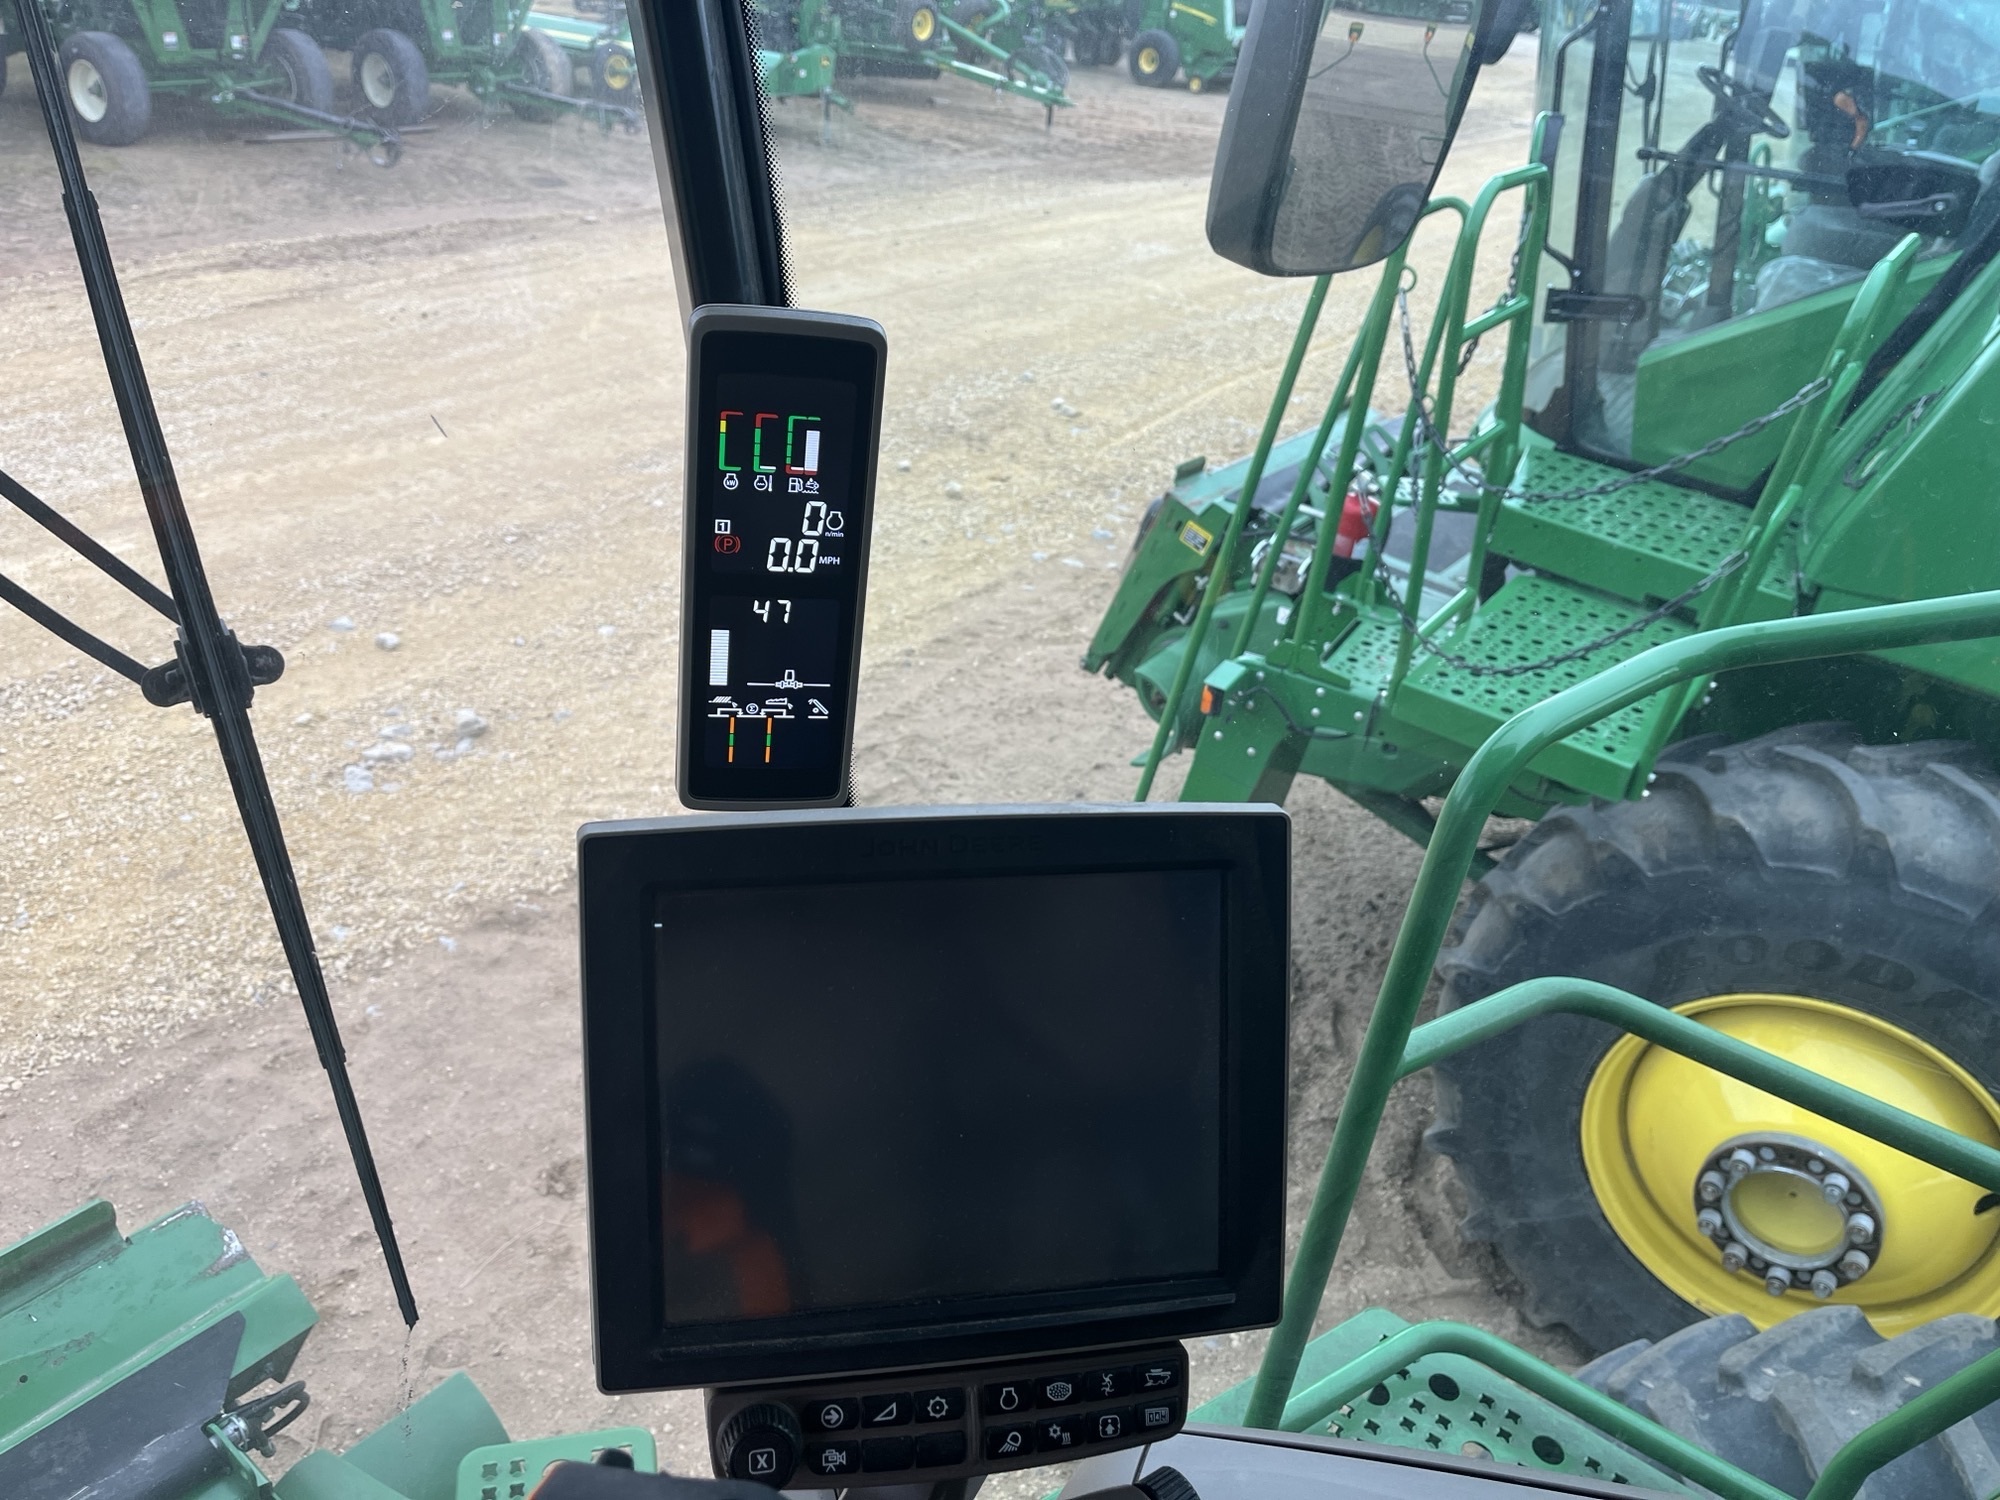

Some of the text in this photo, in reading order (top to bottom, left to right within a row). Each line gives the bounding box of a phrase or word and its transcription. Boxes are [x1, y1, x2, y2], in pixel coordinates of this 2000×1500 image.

[801, 500, 827, 536] 0
[723, 538, 733, 551] P
[766, 537, 840, 573] 0.0 MPH
[859, 833, 1043, 858] JOHN DEERE
[756, 1453, 768, 1469] X
